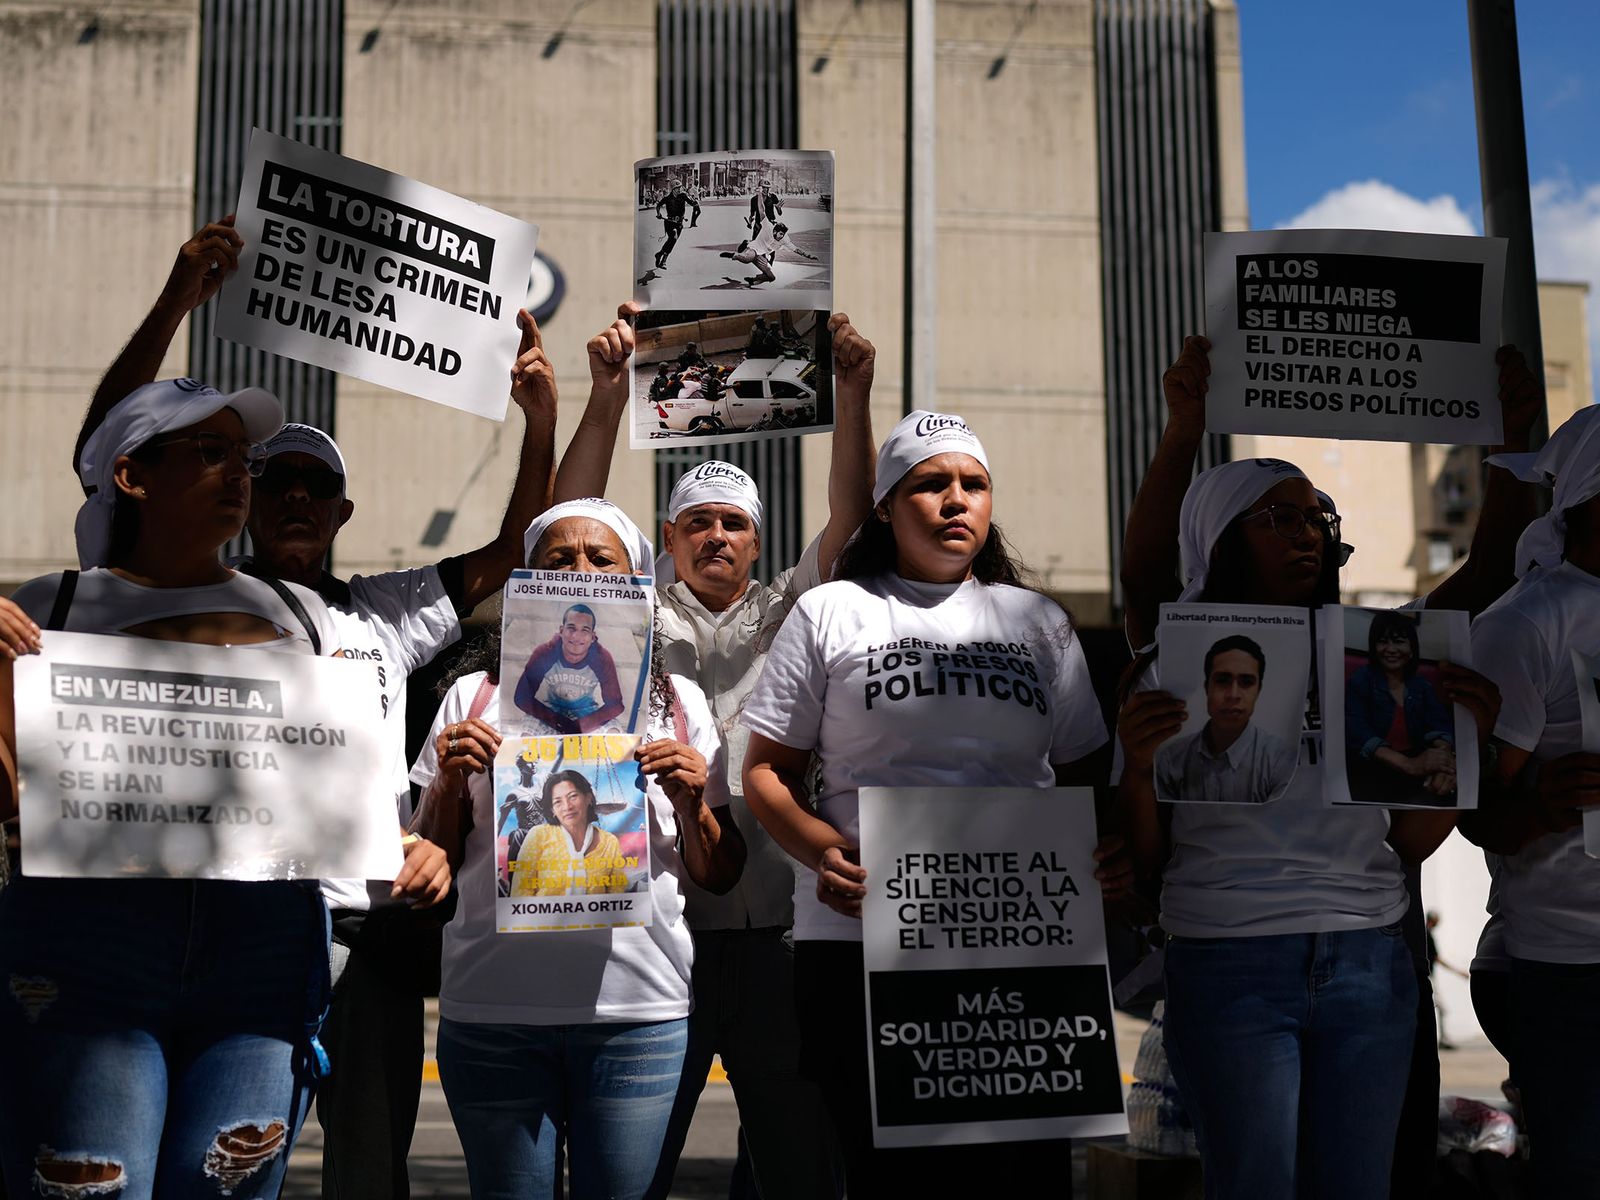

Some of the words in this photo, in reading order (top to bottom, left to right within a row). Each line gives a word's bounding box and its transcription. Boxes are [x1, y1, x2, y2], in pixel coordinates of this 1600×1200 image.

[268, 174, 315, 213] LA
[325, 190, 481, 269] TORTURA
[260, 218, 307, 255] ES
[316, 234, 366, 275] UN
[373, 255, 502, 320] CRIMEN
[1244, 260, 1262, 279] A
[1268, 259, 1319, 279] LOS
[253, 252, 305, 292] DE
[310, 270, 397, 323] LESA
[1245, 284, 1397, 309] FAMILIARES
[246, 288, 462, 377] HUMANIDAD
[1245, 309, 1277, 328] SE
[1284, 311, 1329, 331] LES
[1336, 313, 1413, 336] NIEGA
[1246, 336, 1276, 355] EL
[1282, 337, 1400, 362] DERECHO
[1406, 344, 1423, 363] A
[1245, 361, 1342, 385] VISITAR
[1346, 367, 1364, 386] A
[1370, 369, 1418, 390] LOS
[1244, 389, 1344, 412] PRESOS
[1350, 392, 1481, 420] POLÍTICOS
[514, 582, 543, 595] JOSÉ
[545, 586, 590, 597] MIGUEL
[593, 589, 647, 600] ESTRADA
[536, 572, 592, 583] LIBERTAD
[595, 574, 627, 585] PARA
[1166, 613, 1206, 622] Libertad
[1208, 614, 1230, 624] para
[867, 637, 949, 653] LIBEREN
[956, 643, 969, 652] A
[971, 641, 1032, 657] TODOS
[867, 651, 922, 677] LOS
[932, 652, 1038, 683] PRESOS
[54, 675, 94, 698] EN
[99, 678, 274, 713] VENEZUELA,
[865, 666, 1048, 716] POLÍTICOS
[56, 711, 94, 733] LA
[102, 716, 347, 747] REVICTIMIZACIÓN
[57, 740, 74, 761] Y
[83, 741, 119, 763] LA
[128, 744, 279, 771] INJUSTICIA
[522, 737, 557, 762] 36
[59, 770, 96, 791] SE
[103, 772, 163, 794] HAN
[61, 800, 273, 826] NORMALIZADO
[896, 852, 1020, 879] ¡FRENTE
[1028, 852, 1067, 873] AL
[886, 877, 1032, 901] SILENCIO,
[1041, 875, 1080, 897] LA
[511, 901, 585, 915] XIOMARA
[587, 900, 633, 912] ORTIZ
[898, 901, 1044, 925] CENSURA
[1050, 900, 1070, 921] Y
[899, 928, 934, 950] EL
[941, 925, 1074, 949] TERROR:
[957, 987, 1025, 1015] MÁS
[879, 1015, 1107, 1046] SOLIDARIDAD,
[912, 1045, 1048, 1072] VERDAD
[1055, 1042, 1077, 1065] Y
[913, 1070, 1084, 1100] DIGNIDAD!
